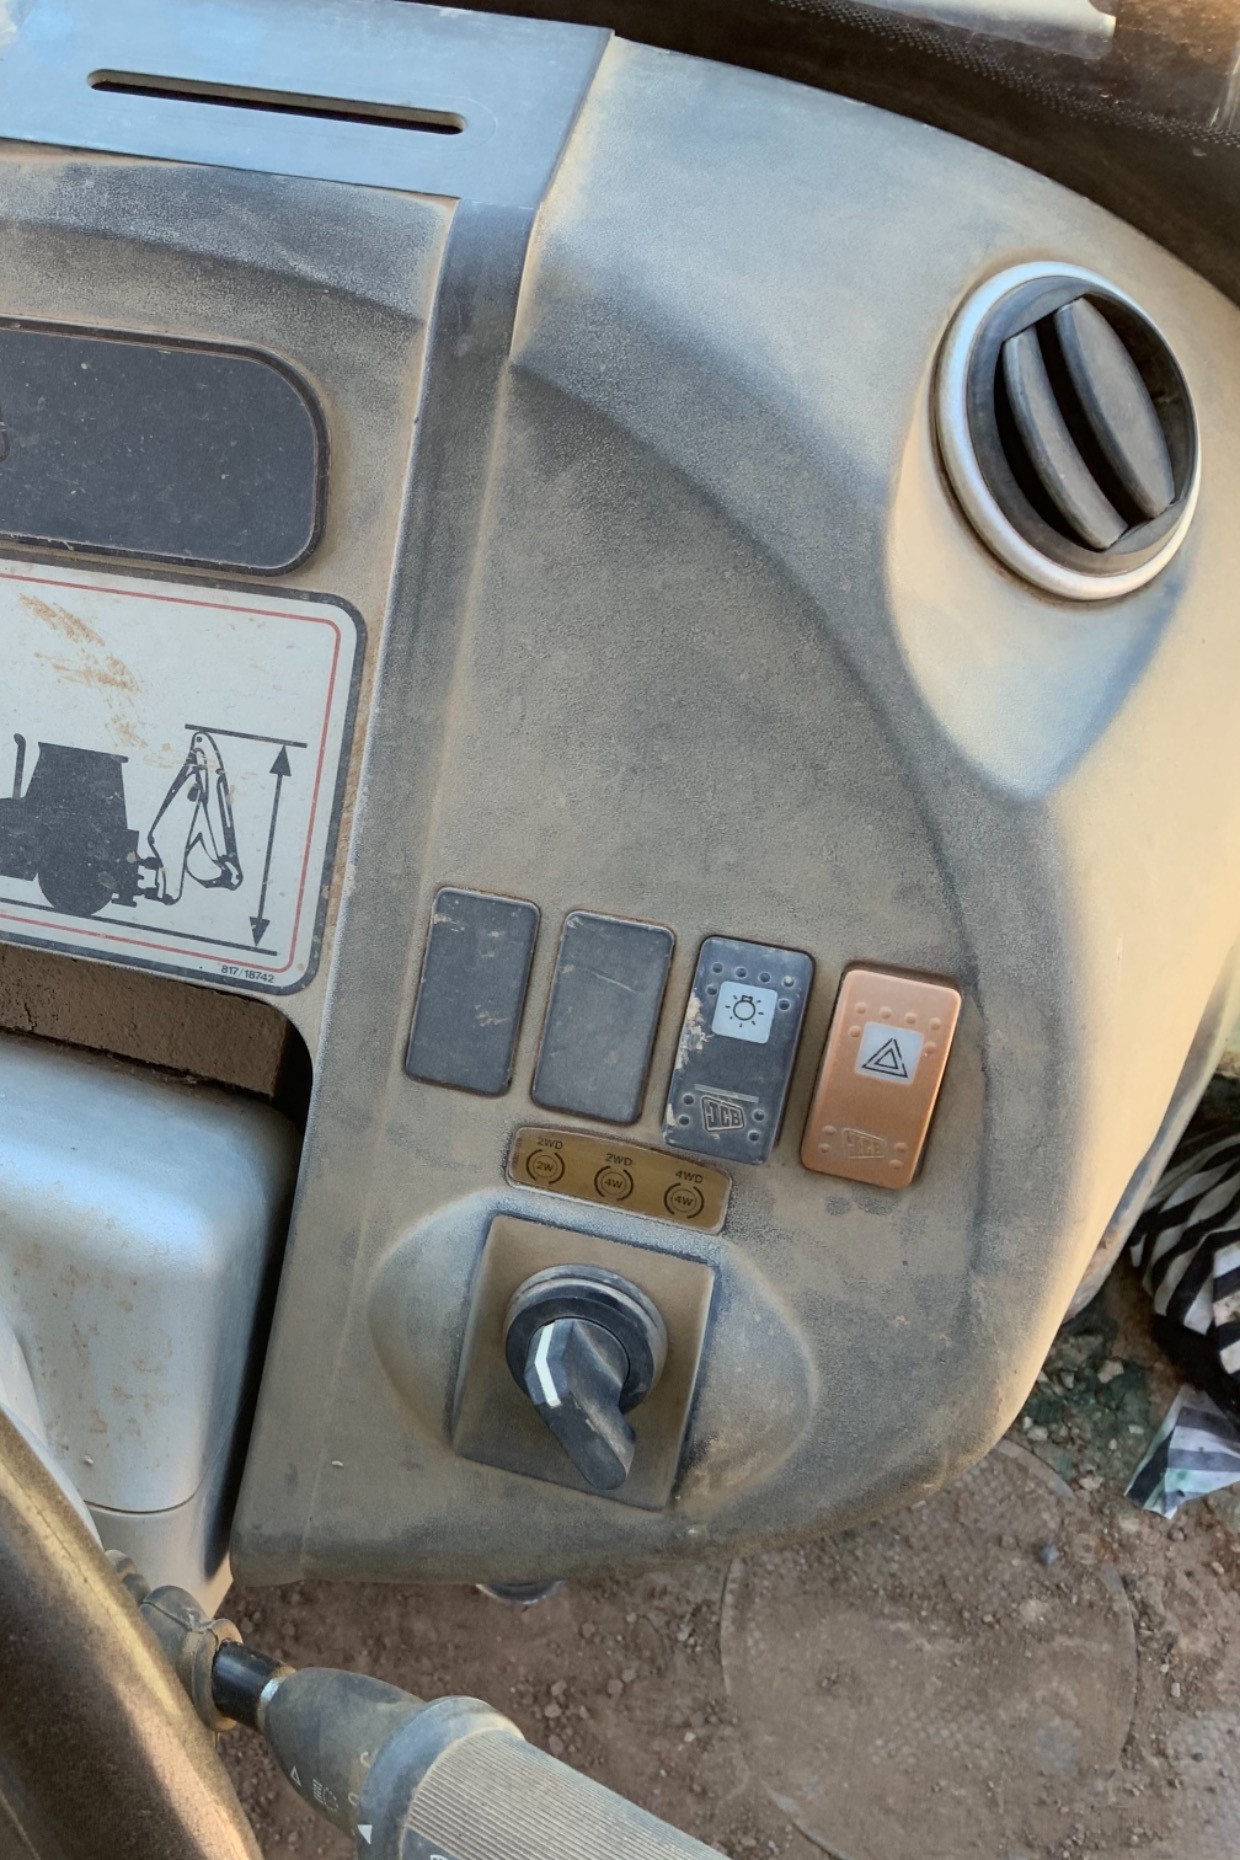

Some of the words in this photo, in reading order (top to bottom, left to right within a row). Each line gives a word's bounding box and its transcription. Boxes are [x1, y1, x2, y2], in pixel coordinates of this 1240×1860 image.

[221, 964, 275, 983] 817/18742
[705, 1098, 742, 1129] JCB
[537, 1136, 564, 1150] 2WD
[605, 1153, 633, 1167] 2WD
[674, 1170, 704, 1184] 4WD
[536, 1160, 554, 1172] 2W
[605, 1177, 623, 1189] 4W
[674, 1194, 694, 1207] 4W
